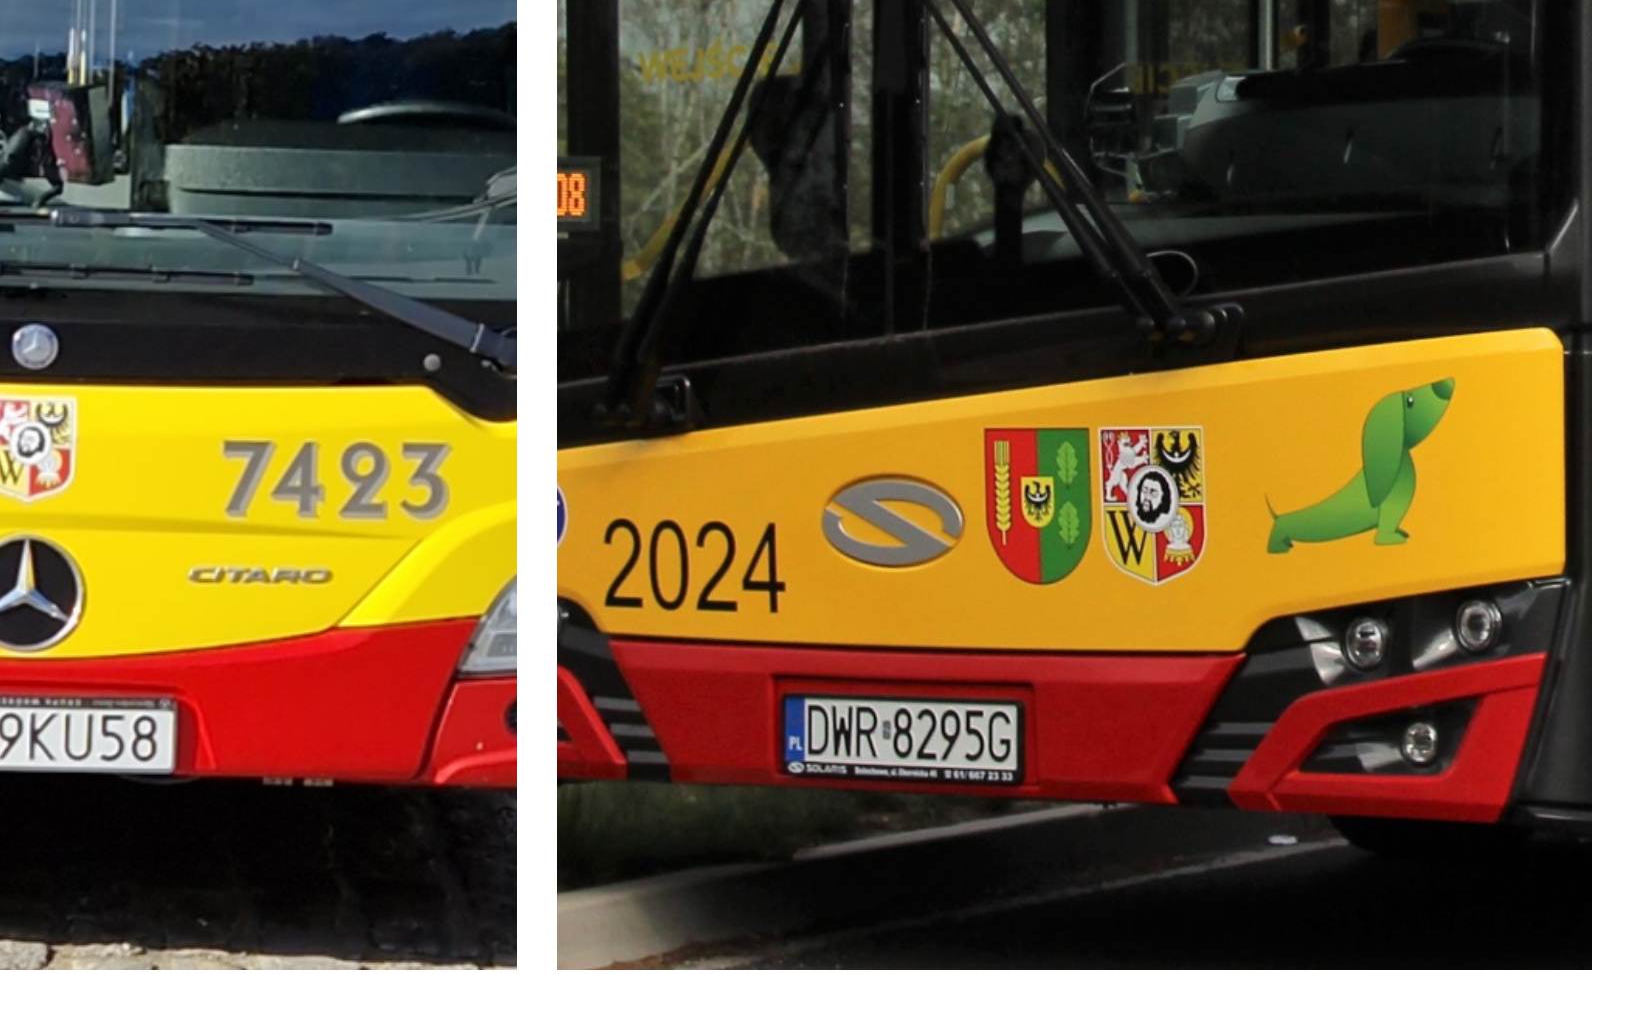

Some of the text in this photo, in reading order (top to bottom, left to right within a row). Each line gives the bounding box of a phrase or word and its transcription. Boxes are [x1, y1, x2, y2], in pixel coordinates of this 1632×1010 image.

[222, 440, 452, 520] 7423
[189, 567, 334, 585] CITARO
[603, 517, 786, 613] 2024
[788, 735, 803, 751] PL
[807, 704, 1012, 763] DWR 8295G
